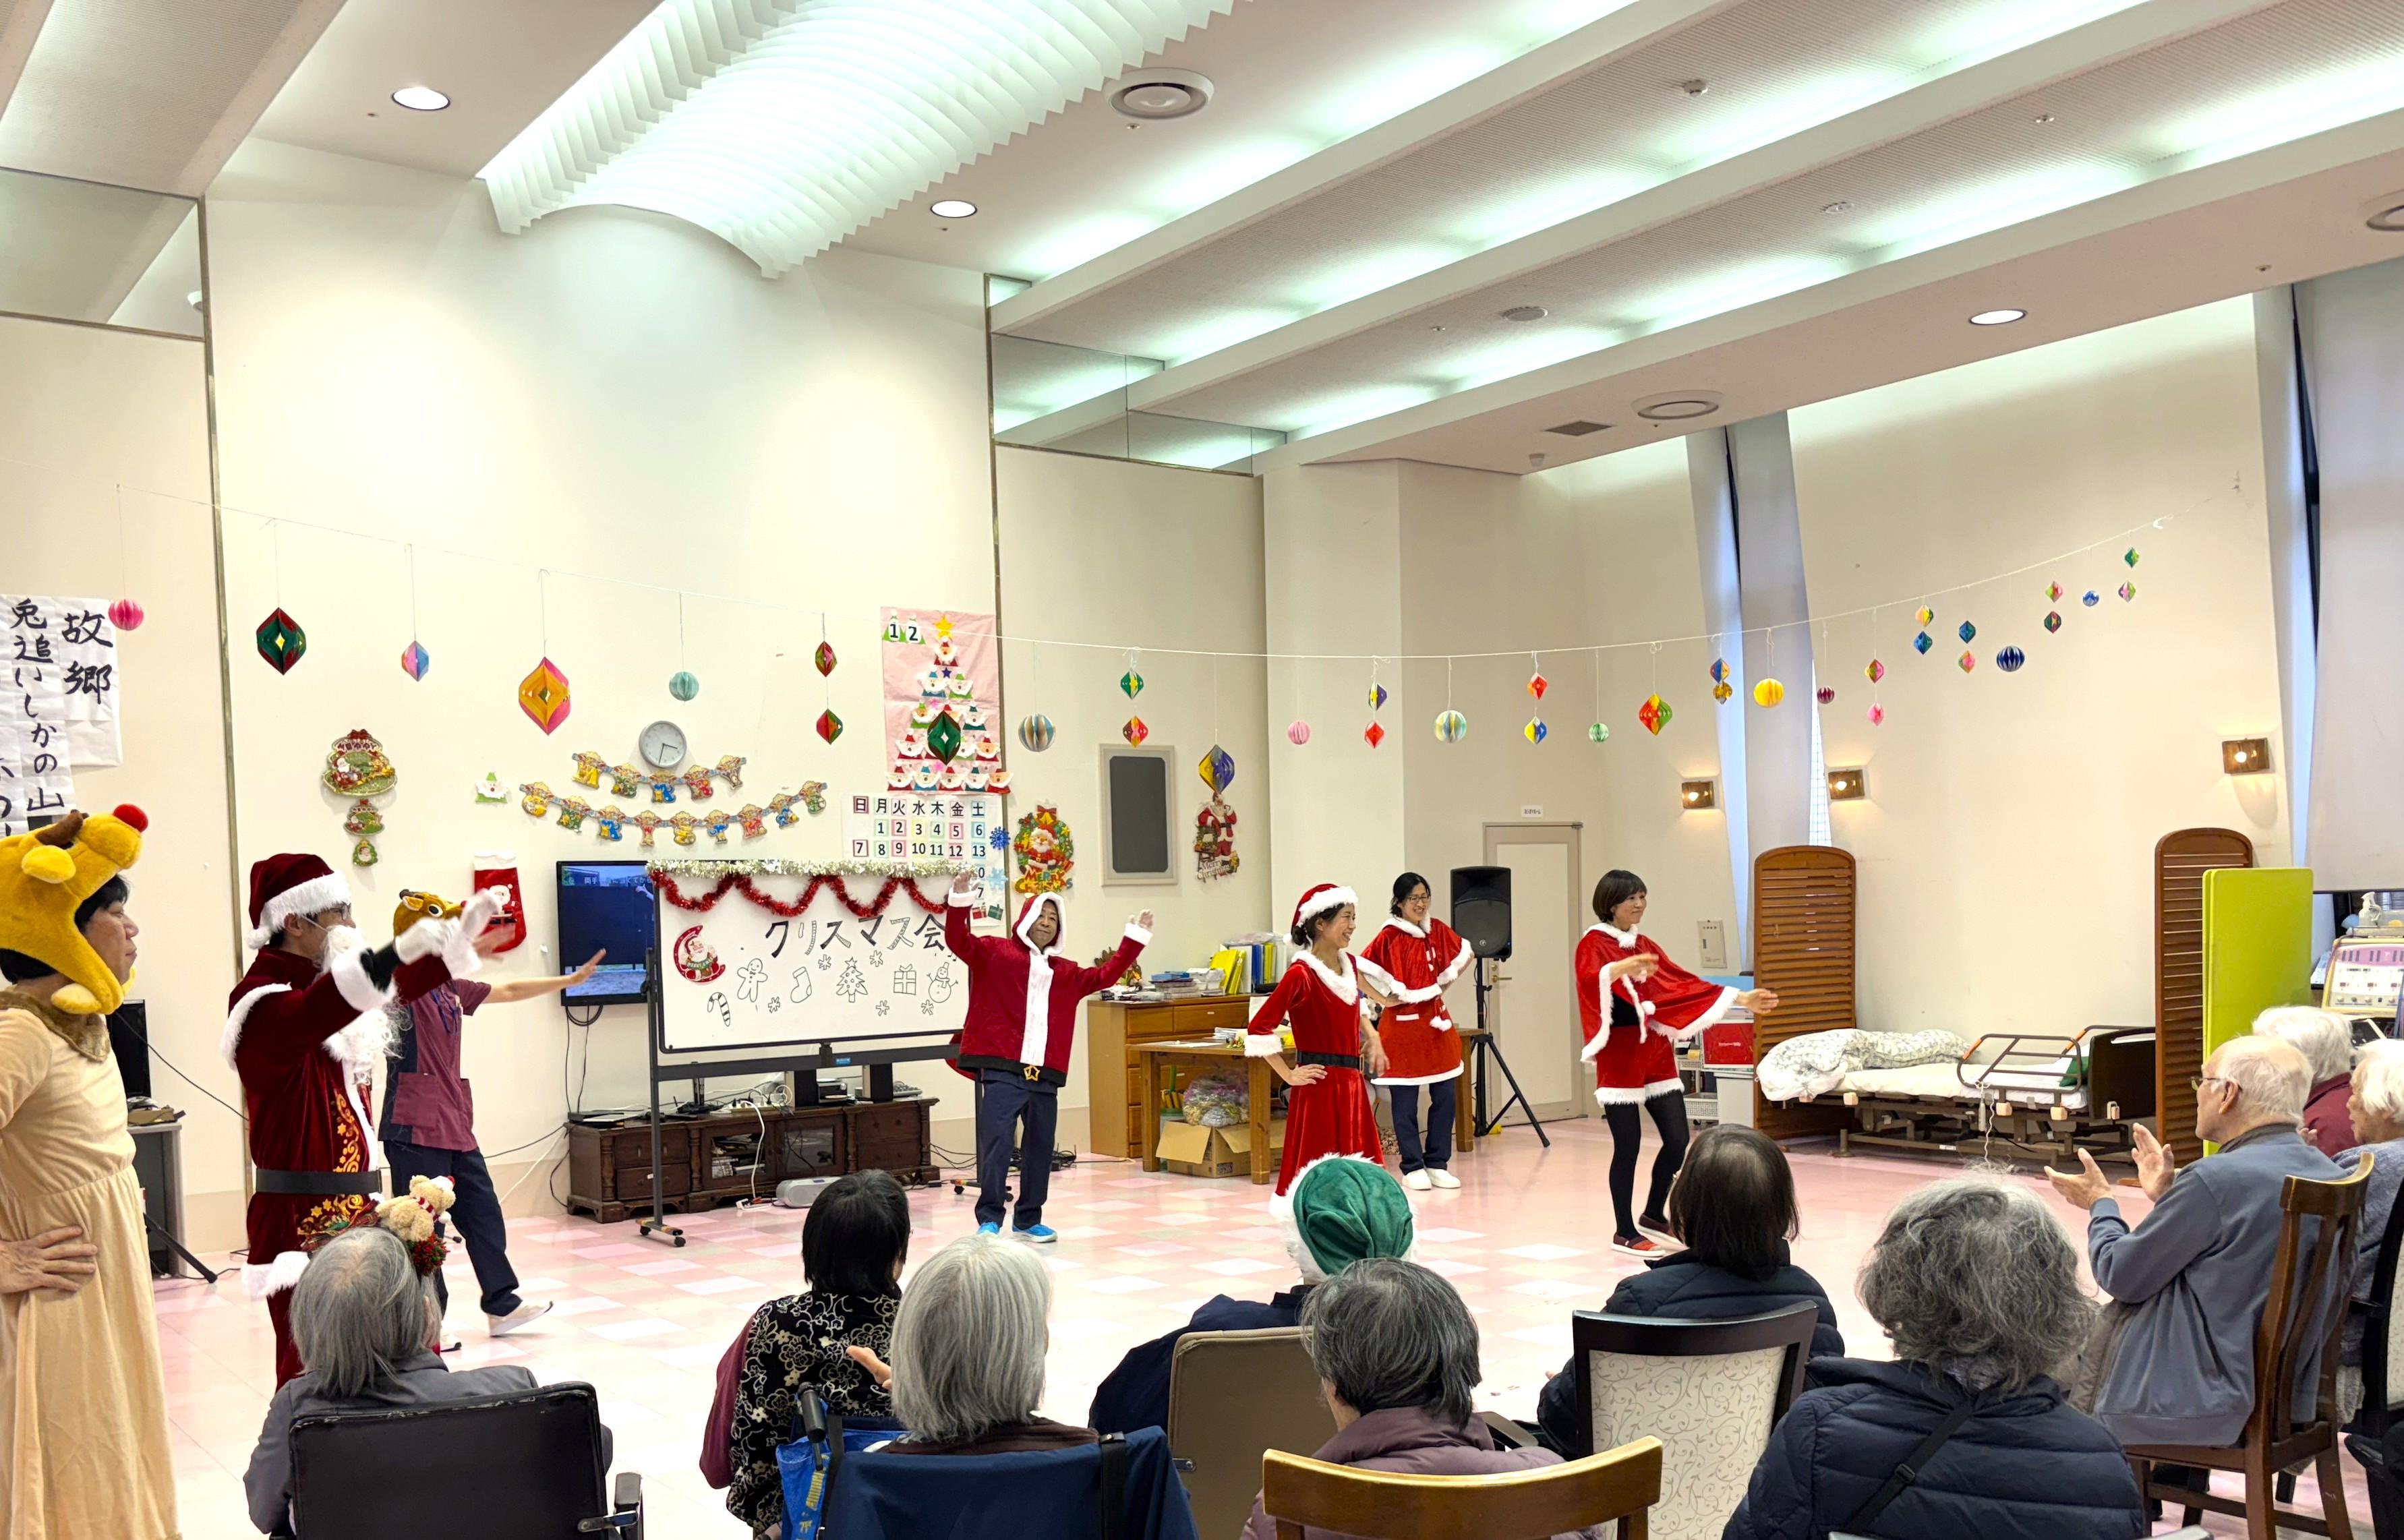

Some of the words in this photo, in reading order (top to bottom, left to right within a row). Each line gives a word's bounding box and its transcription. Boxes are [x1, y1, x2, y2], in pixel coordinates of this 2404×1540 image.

[890, 623, 918, 641] 12
[62, 610, 113, 705] 故郷
[856, 798, 866, 811] 日
[876, 798, 887, 813] 月
[893, 800, 905, 815] 火
[912, 800, 925, 815] 水
[931, 801, 944, 815] 木
[951, 802, 964, 817] 金
[972, 802, 985, 816] 土
[877, 822, 885, 833] 1
[896, 822, 903, 833] 2
[915, 824, 922, 835] 3
[933, 824, 941, 835] 4
[953, 825, 960, 837] 5
[976, 825, 983, 835] 6
[856, 842, 863, 854] 7
[878, 843, 885, 856] 8
[896, 842, 903, 854] 9
[912, 843, 926, 854] 10
[930, 844, 944, 856] 11
[949, 846, 963, 857] 12
[972, 846, 986, 857] 13
[765, 914, 945, 958] クリスマス会
